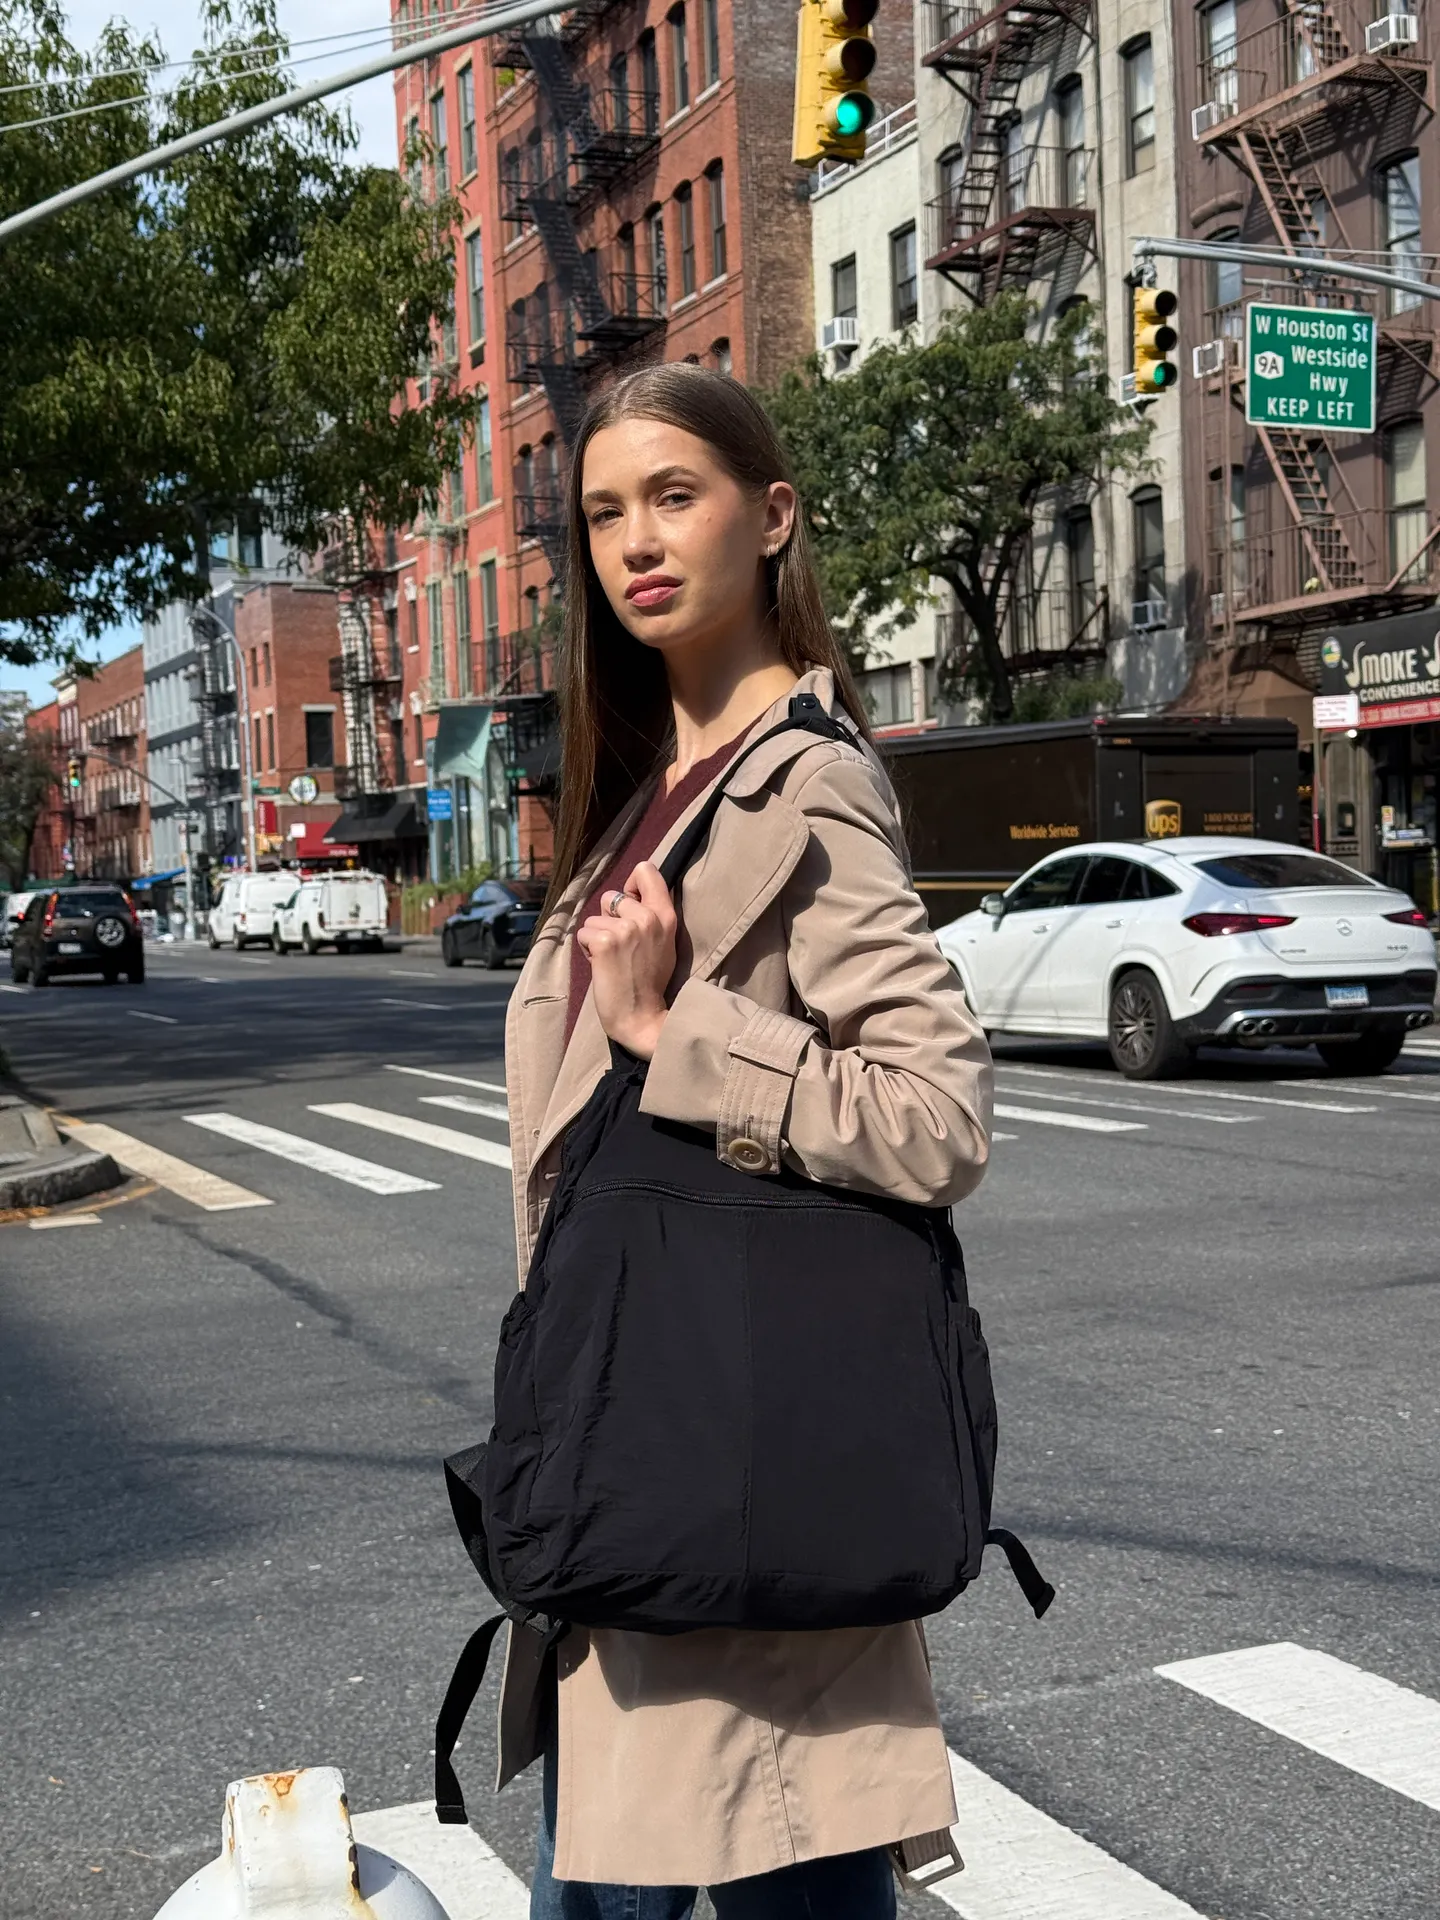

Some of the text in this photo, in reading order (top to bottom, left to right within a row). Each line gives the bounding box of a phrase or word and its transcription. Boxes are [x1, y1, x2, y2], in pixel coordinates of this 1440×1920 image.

[1255, 314, 1368, 343] W Houston St
[1257, 356, 1281, 375] 9A
[1291, 345, 1368, 369] Westside
[1309, 371, 1349, 399] Hwy
[1267, 396, 1354, 421] KEEP LEFT
[1360, 678, 1440, 703] CONVENIENCE
[1048, 822, 1080, 838] Services
